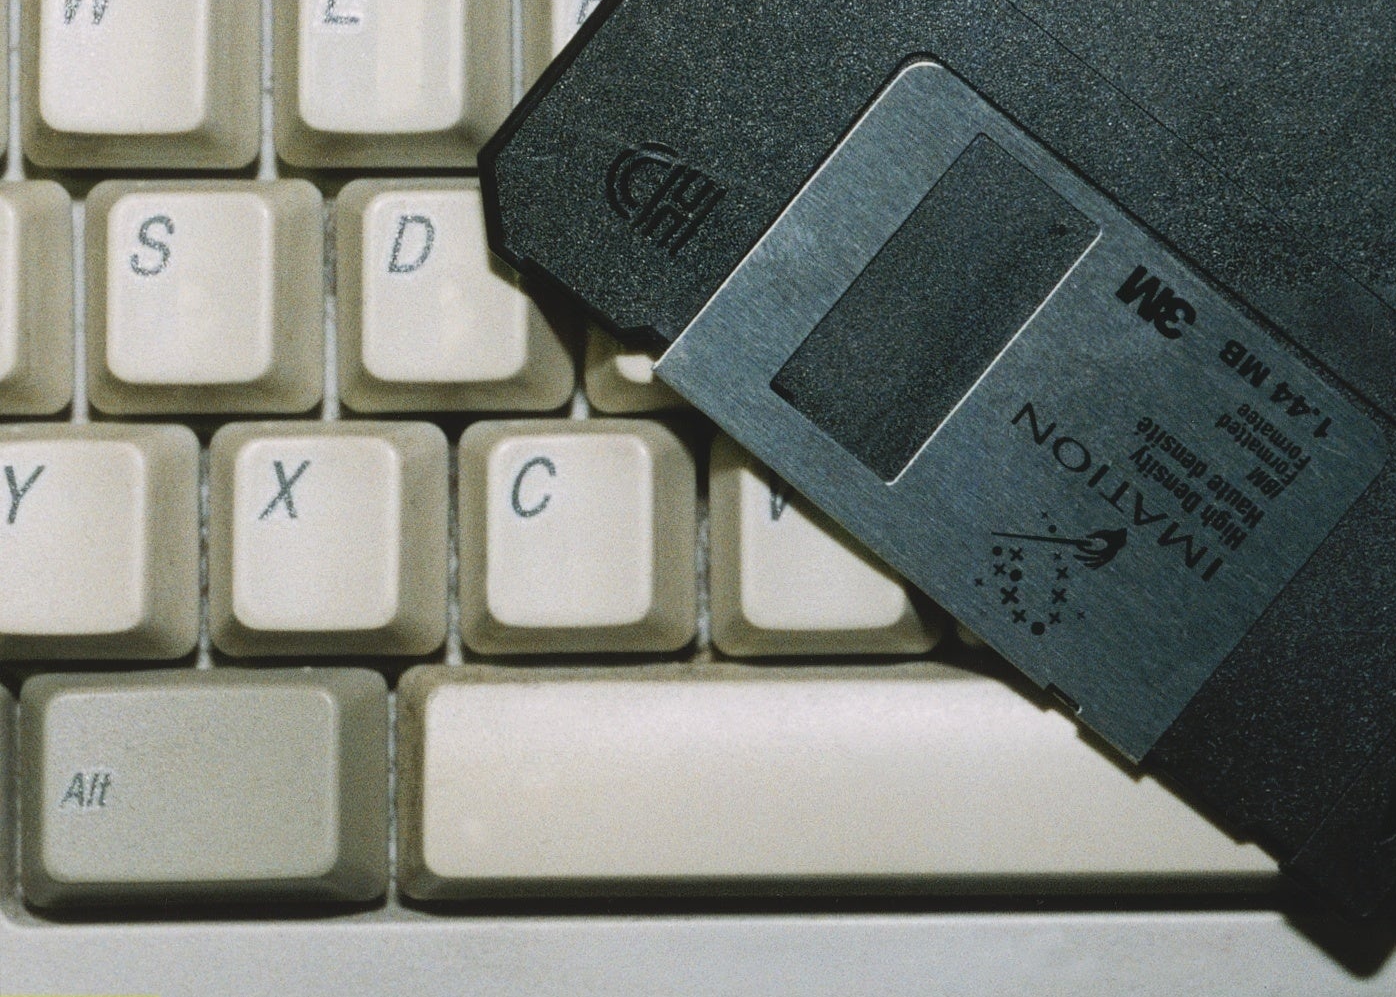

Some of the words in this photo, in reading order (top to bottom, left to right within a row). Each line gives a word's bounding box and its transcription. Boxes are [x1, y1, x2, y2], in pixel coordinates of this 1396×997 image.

[130, 214, 176, 277] S
[387, 214, 436, 274] D
[1115, 265, 1197, 340] 3M
[1219, 340, 1271, 388] MB
[1269, 381, 1332, 438] 1.44
[1136, 417, 1208, 479] densité
[1214, 413, 1299, 487] Formatted
[3, 464, 46, 525] Y
[259, 459, 311, 520] X
[510, 456, 557, 519] C
[1011, 403, 1224, 583] IMATION
[1129, 445, 1203, 515] Density
[1206, 474, 1265, 530] Haute
[1246, 466, 1285, 500] IBM
[1200, 504, 1248, 551] High
[61, 771, 112, 808] Alt
